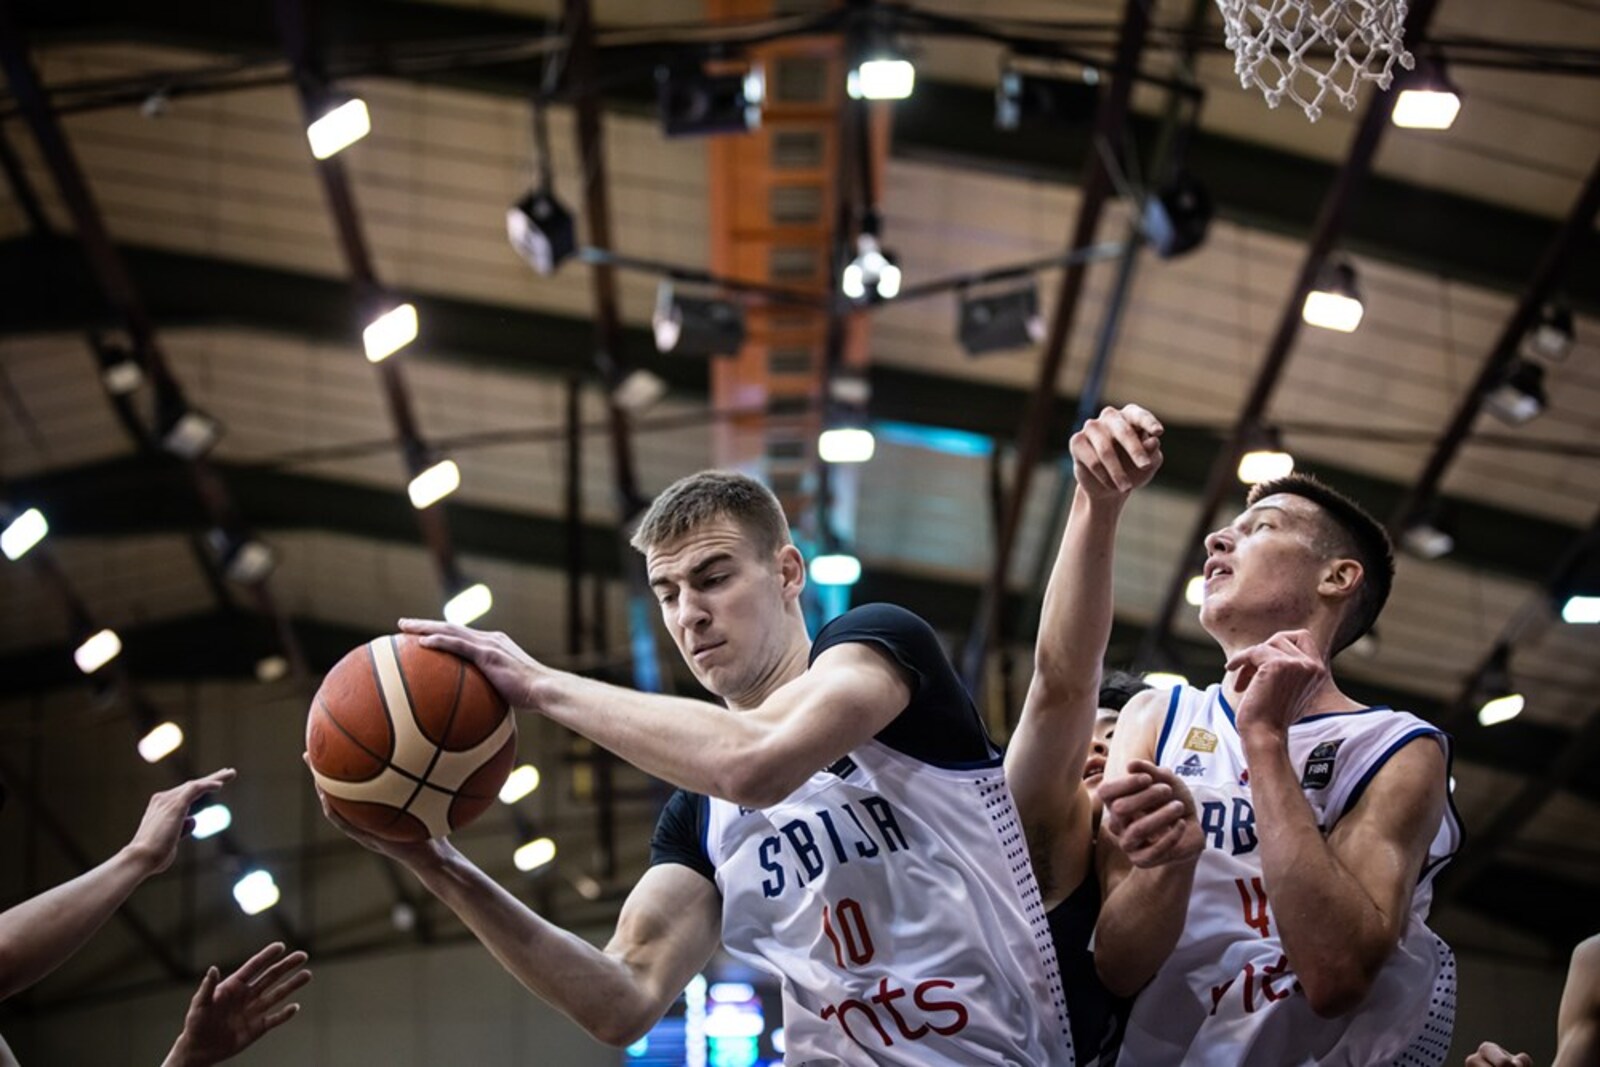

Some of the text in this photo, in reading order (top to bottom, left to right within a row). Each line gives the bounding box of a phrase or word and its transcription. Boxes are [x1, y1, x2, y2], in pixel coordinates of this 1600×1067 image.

[1308, 762, 1329, 775] FIBA
[758, 796, 910, 898] SBIJA
[822, 898, 875, 969] 10
[1235, 877, 1270, 938] 4
